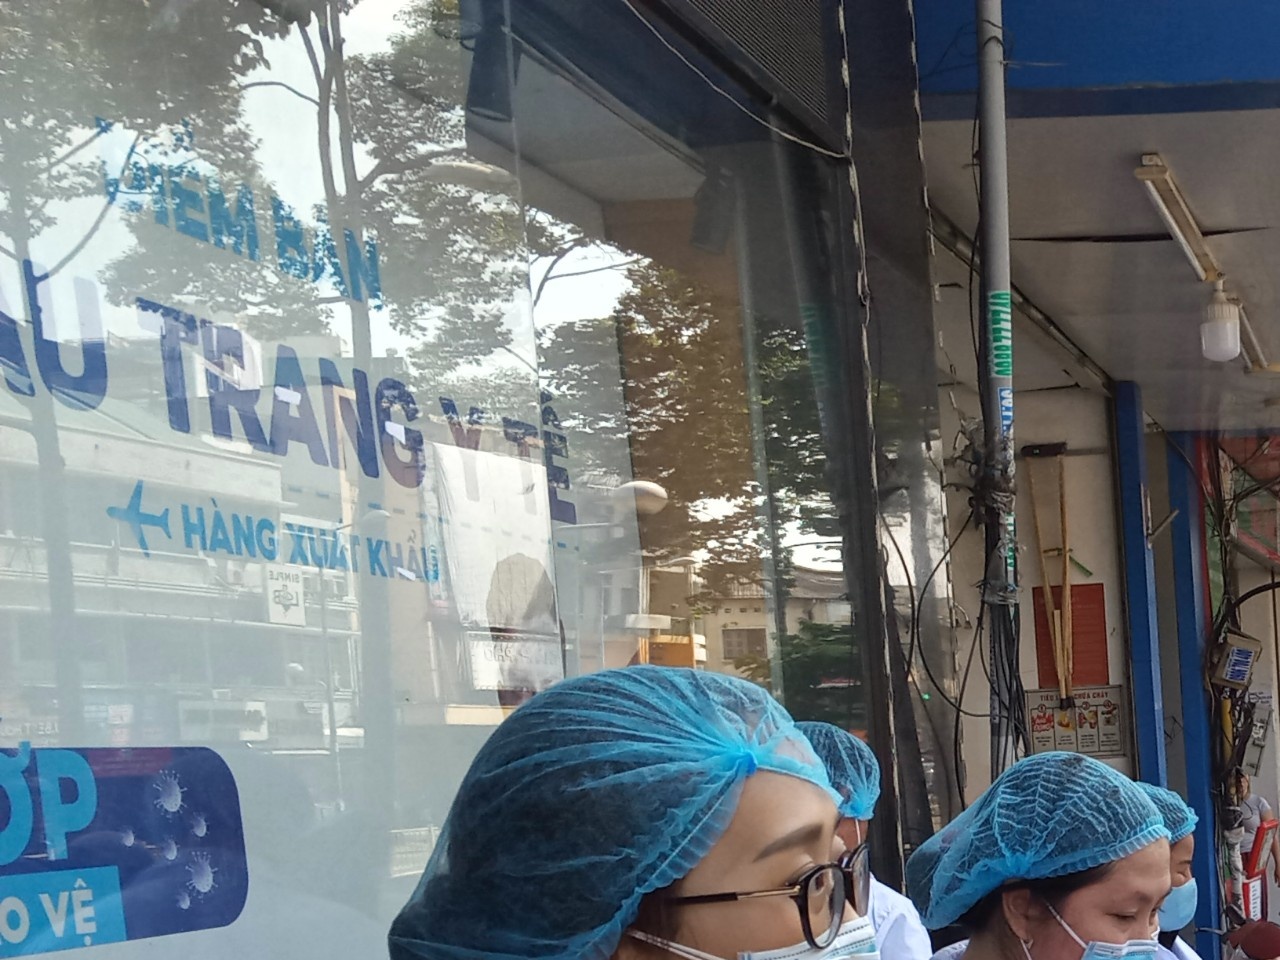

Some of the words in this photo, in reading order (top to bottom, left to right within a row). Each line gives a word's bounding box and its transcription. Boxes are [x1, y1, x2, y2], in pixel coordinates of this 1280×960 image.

[135, 297, 427, 488] TRANG
[181, 497, 279, 561] HÀNG
[39, 877, 97, 946] VỆ
